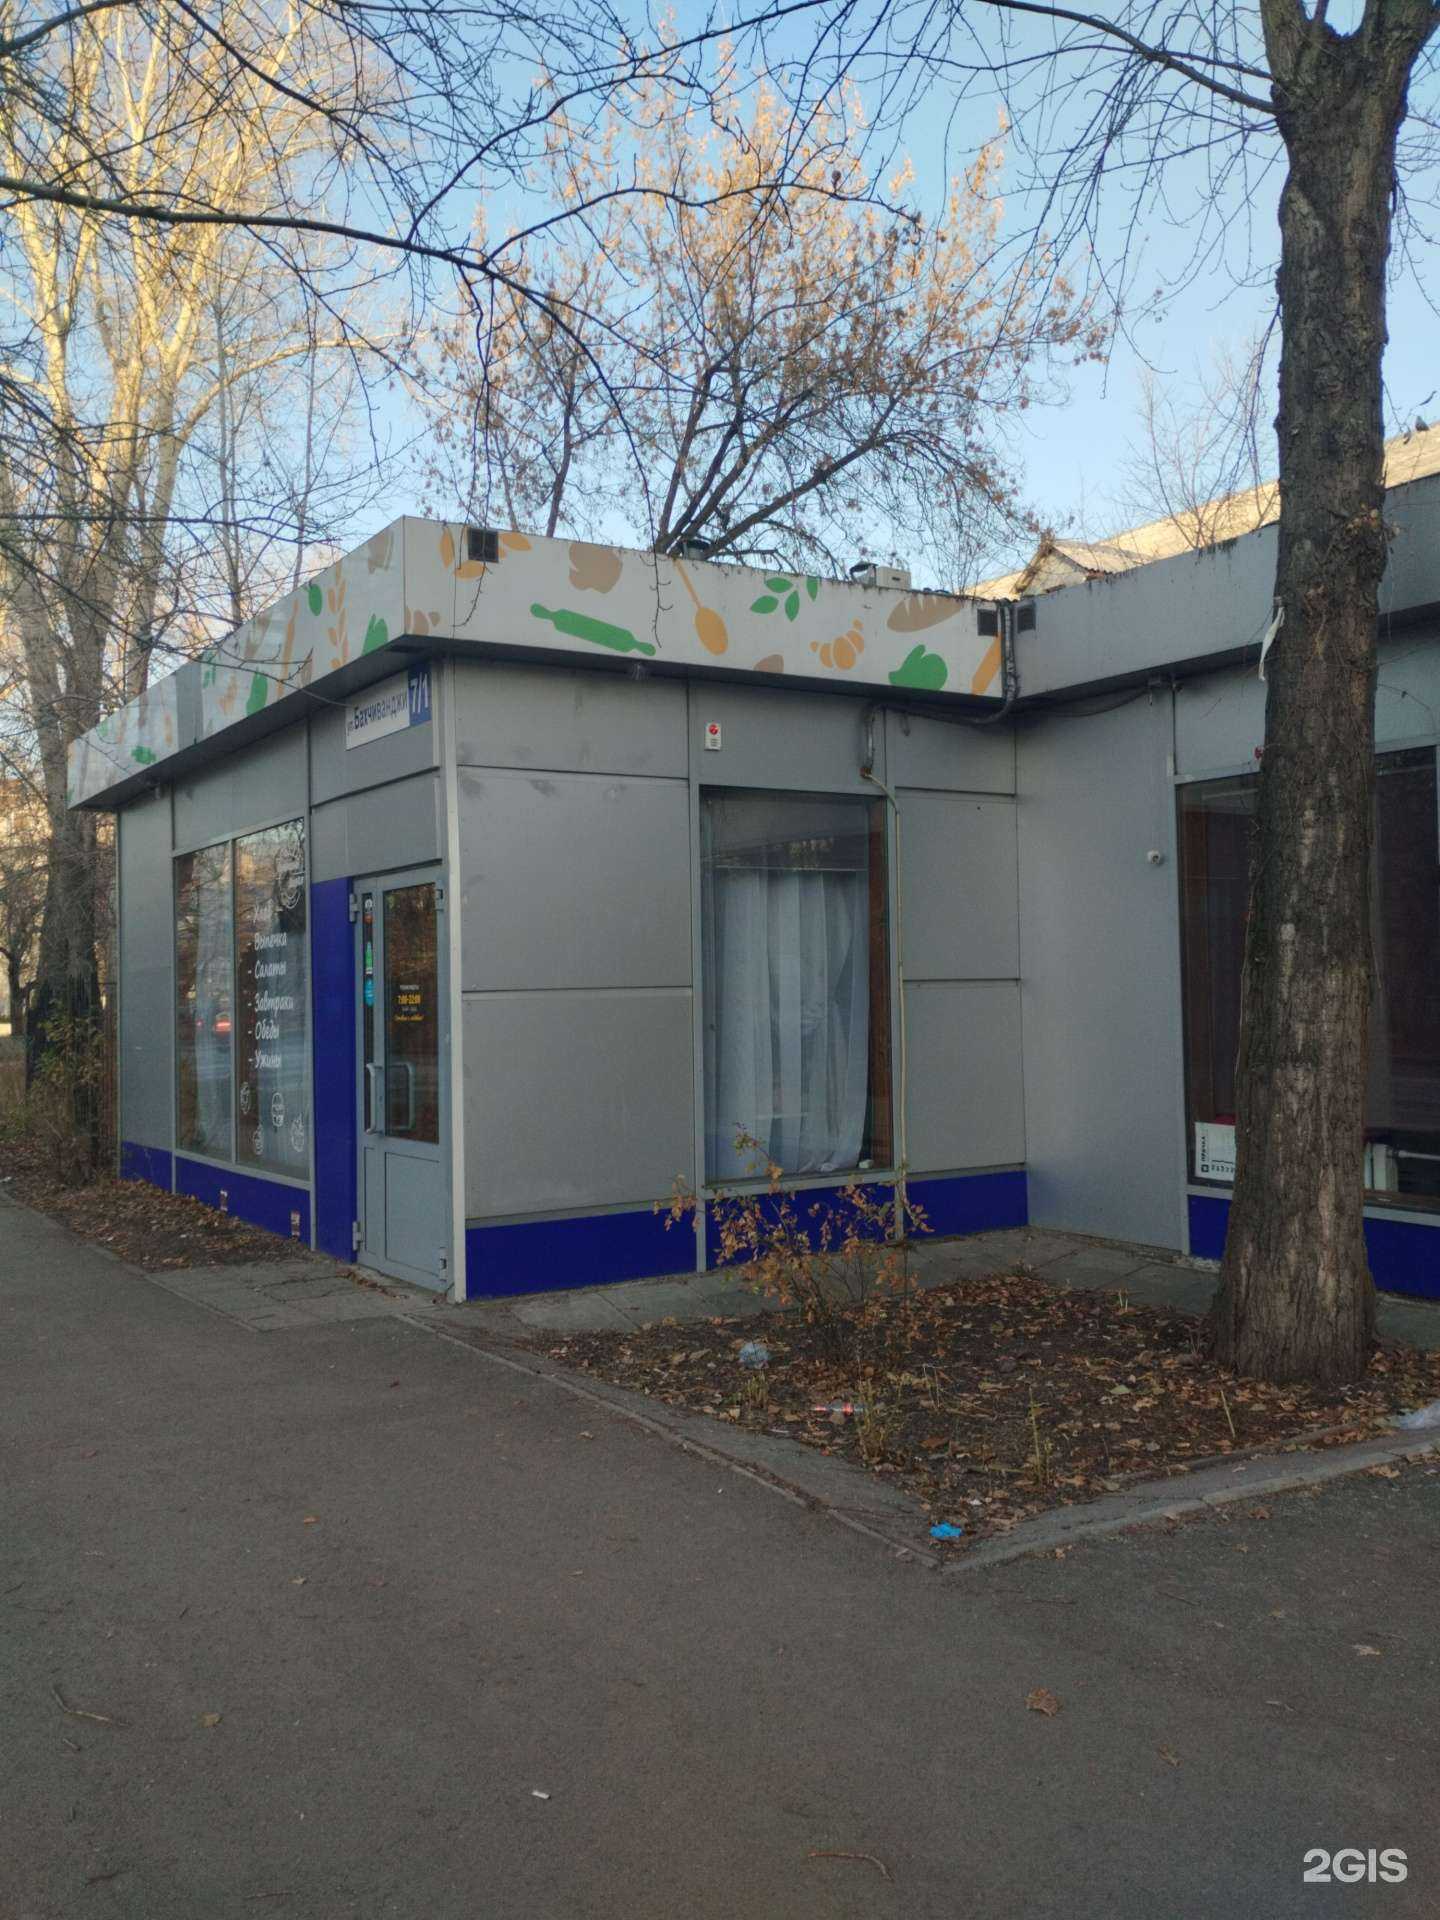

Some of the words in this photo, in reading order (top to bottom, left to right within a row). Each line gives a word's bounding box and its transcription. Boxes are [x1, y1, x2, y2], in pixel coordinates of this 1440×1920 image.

[410, 672, 428, 713] 7/1
[254, 931, 287, 951] Выпечка
[254, 959, 287, 980] Салаты
[254, 989, 294, 1018] Завтраки
[254, 1018, 280, 1040] Обеды
[254, 1048, 281, 1070] Ужины
